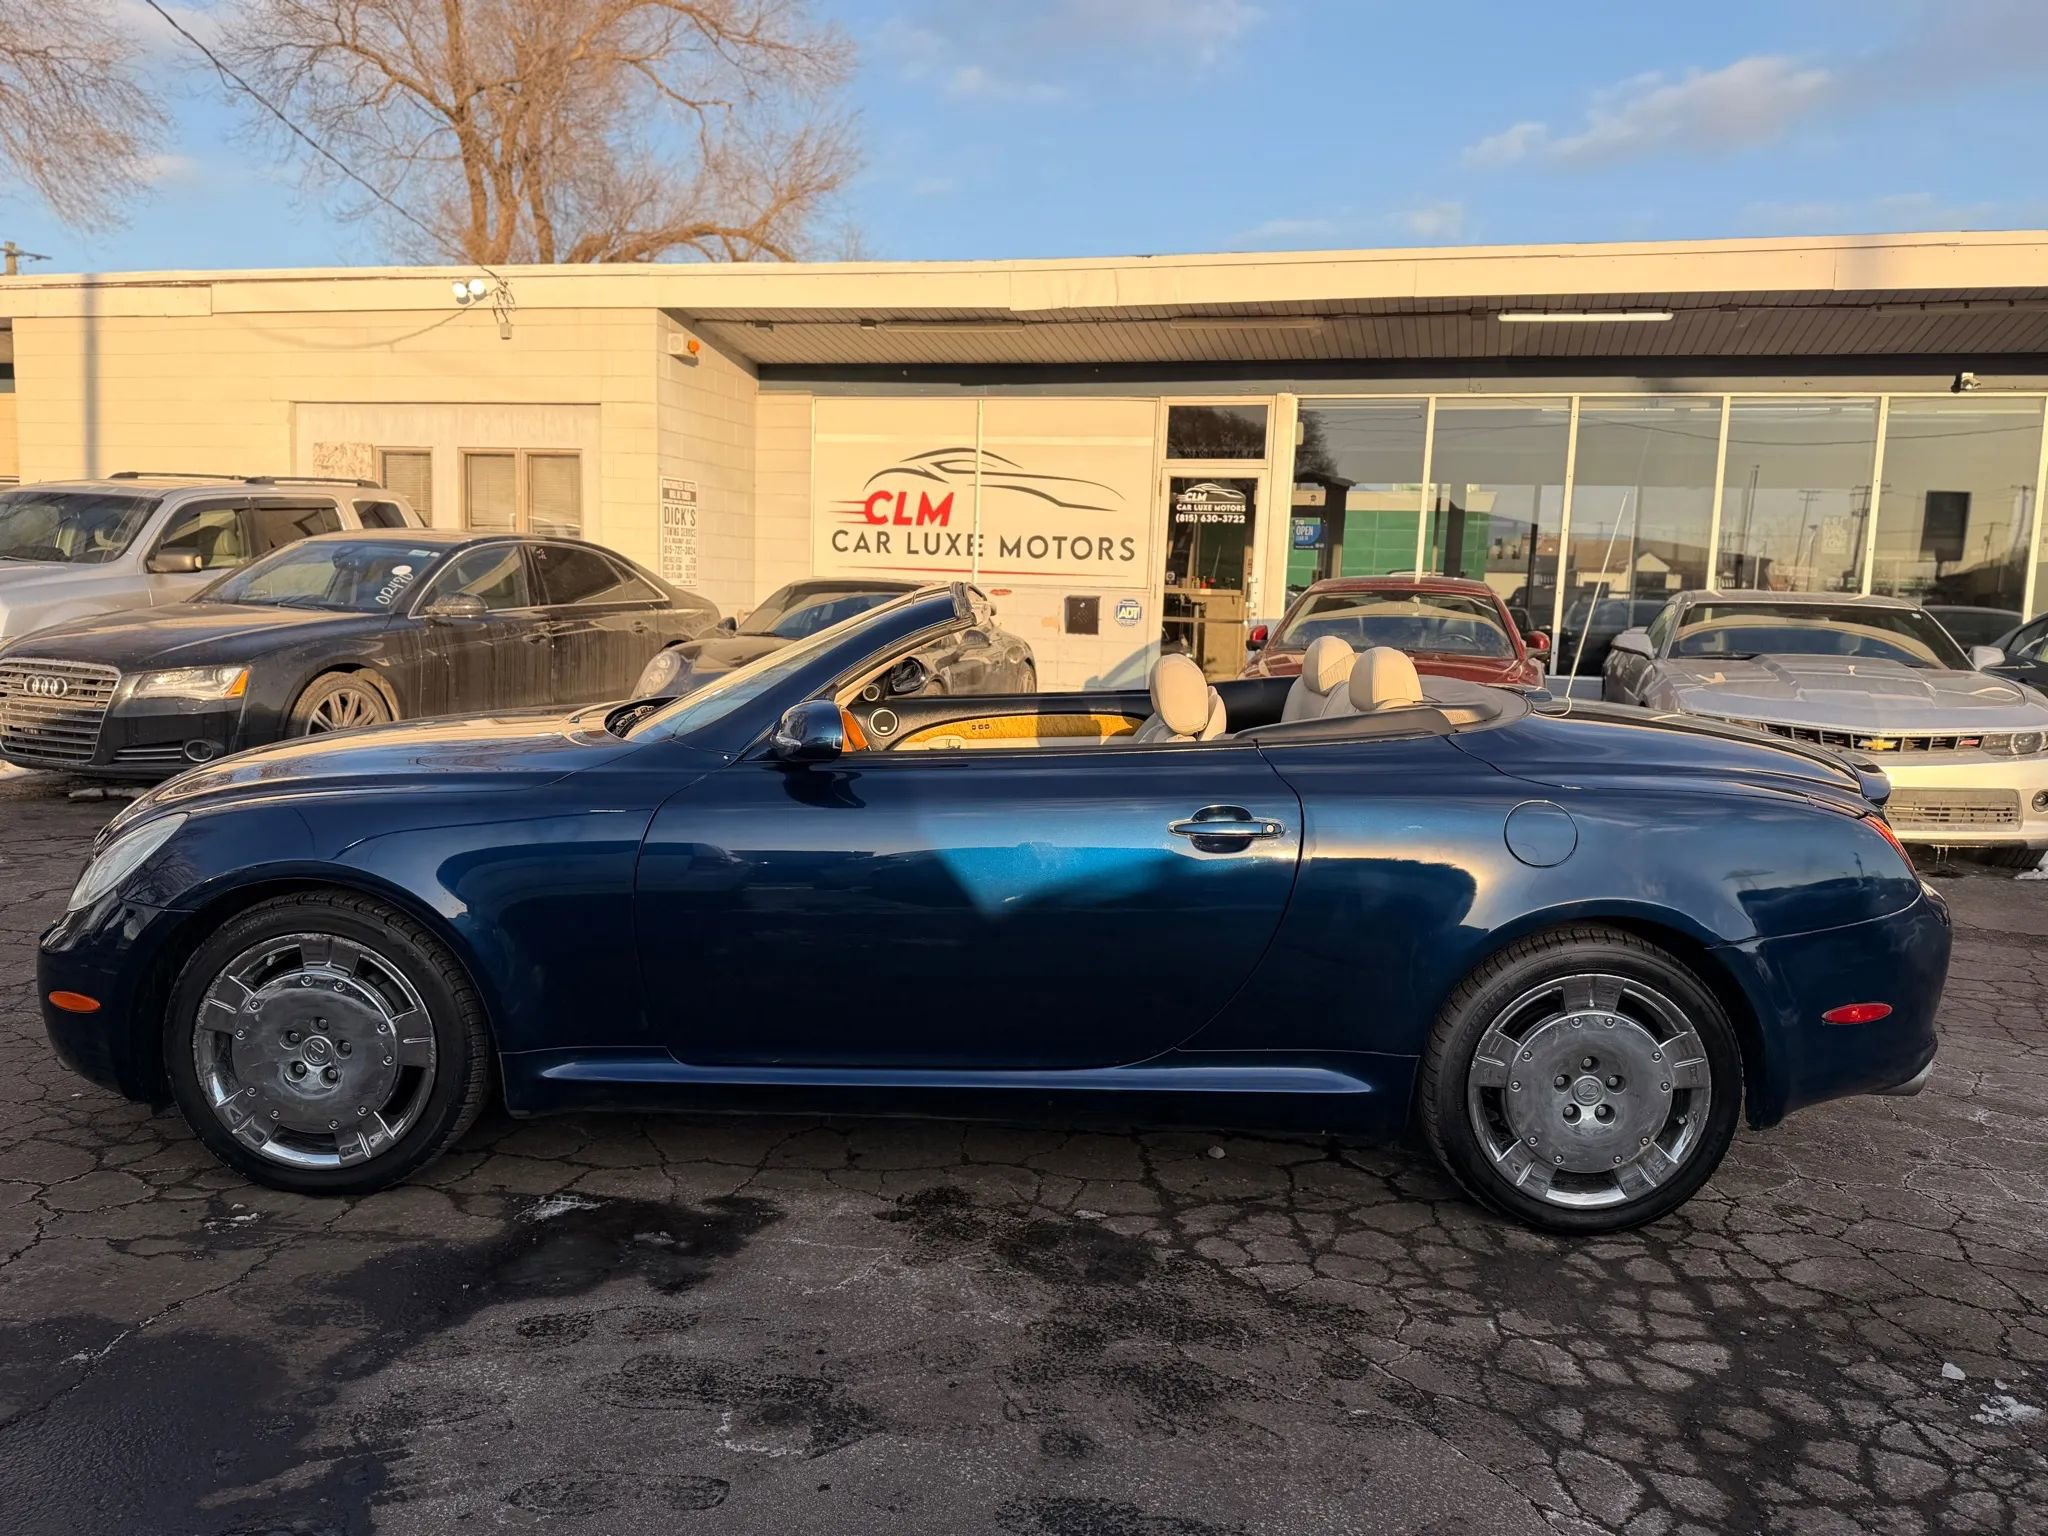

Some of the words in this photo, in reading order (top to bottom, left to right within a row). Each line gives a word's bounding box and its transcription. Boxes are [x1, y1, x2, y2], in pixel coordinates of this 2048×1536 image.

[1185, 492, 1208, 502] CLM
[864, 490, 954, 527] CLM
[664, 506, 696, 527] DICK'S
[1175, 514, 1198, 523] (815)
[1200, 515, 1246, 523] 630-3722
[1296, 525, 1313, 536] OPEN
[832, 530, 891, 554] CAR
[906, 531, 984, 557] LUXE
[1000, 535, 1136, 561] MOTORS
[1119, 606, 1138, 620] ADT
